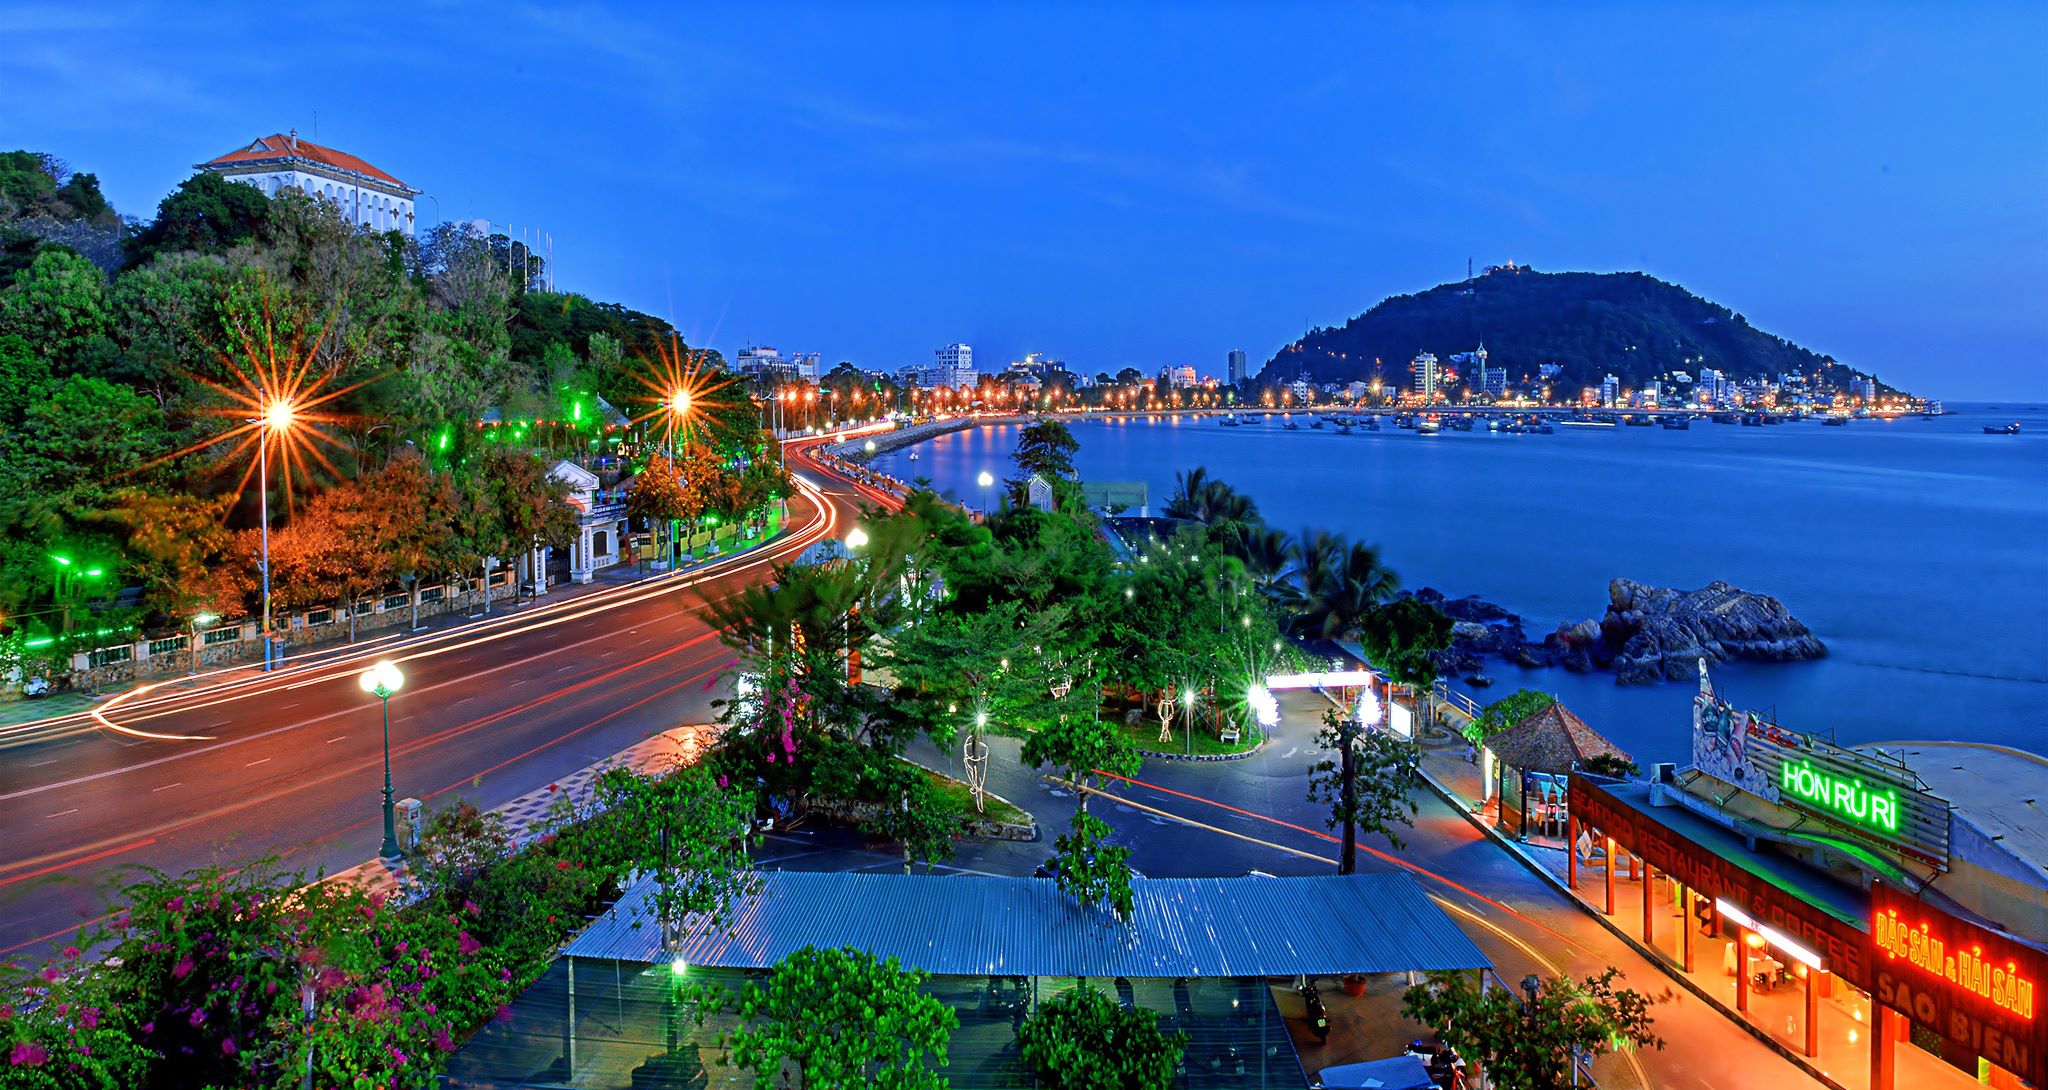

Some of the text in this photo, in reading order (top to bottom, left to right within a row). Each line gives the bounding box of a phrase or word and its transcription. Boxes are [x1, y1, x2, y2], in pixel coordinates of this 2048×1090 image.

[1783, 760, 1896, 830] HÒN RÙ RÌ
[1571, 787, 1859, 966] SEAFOOD RESTAURANT & COFFEE
[1876, 909, 2034, 1019] ĐẶC SẢN & HẢI SẢN
[1878, 971, 1937, 1025] SAO
